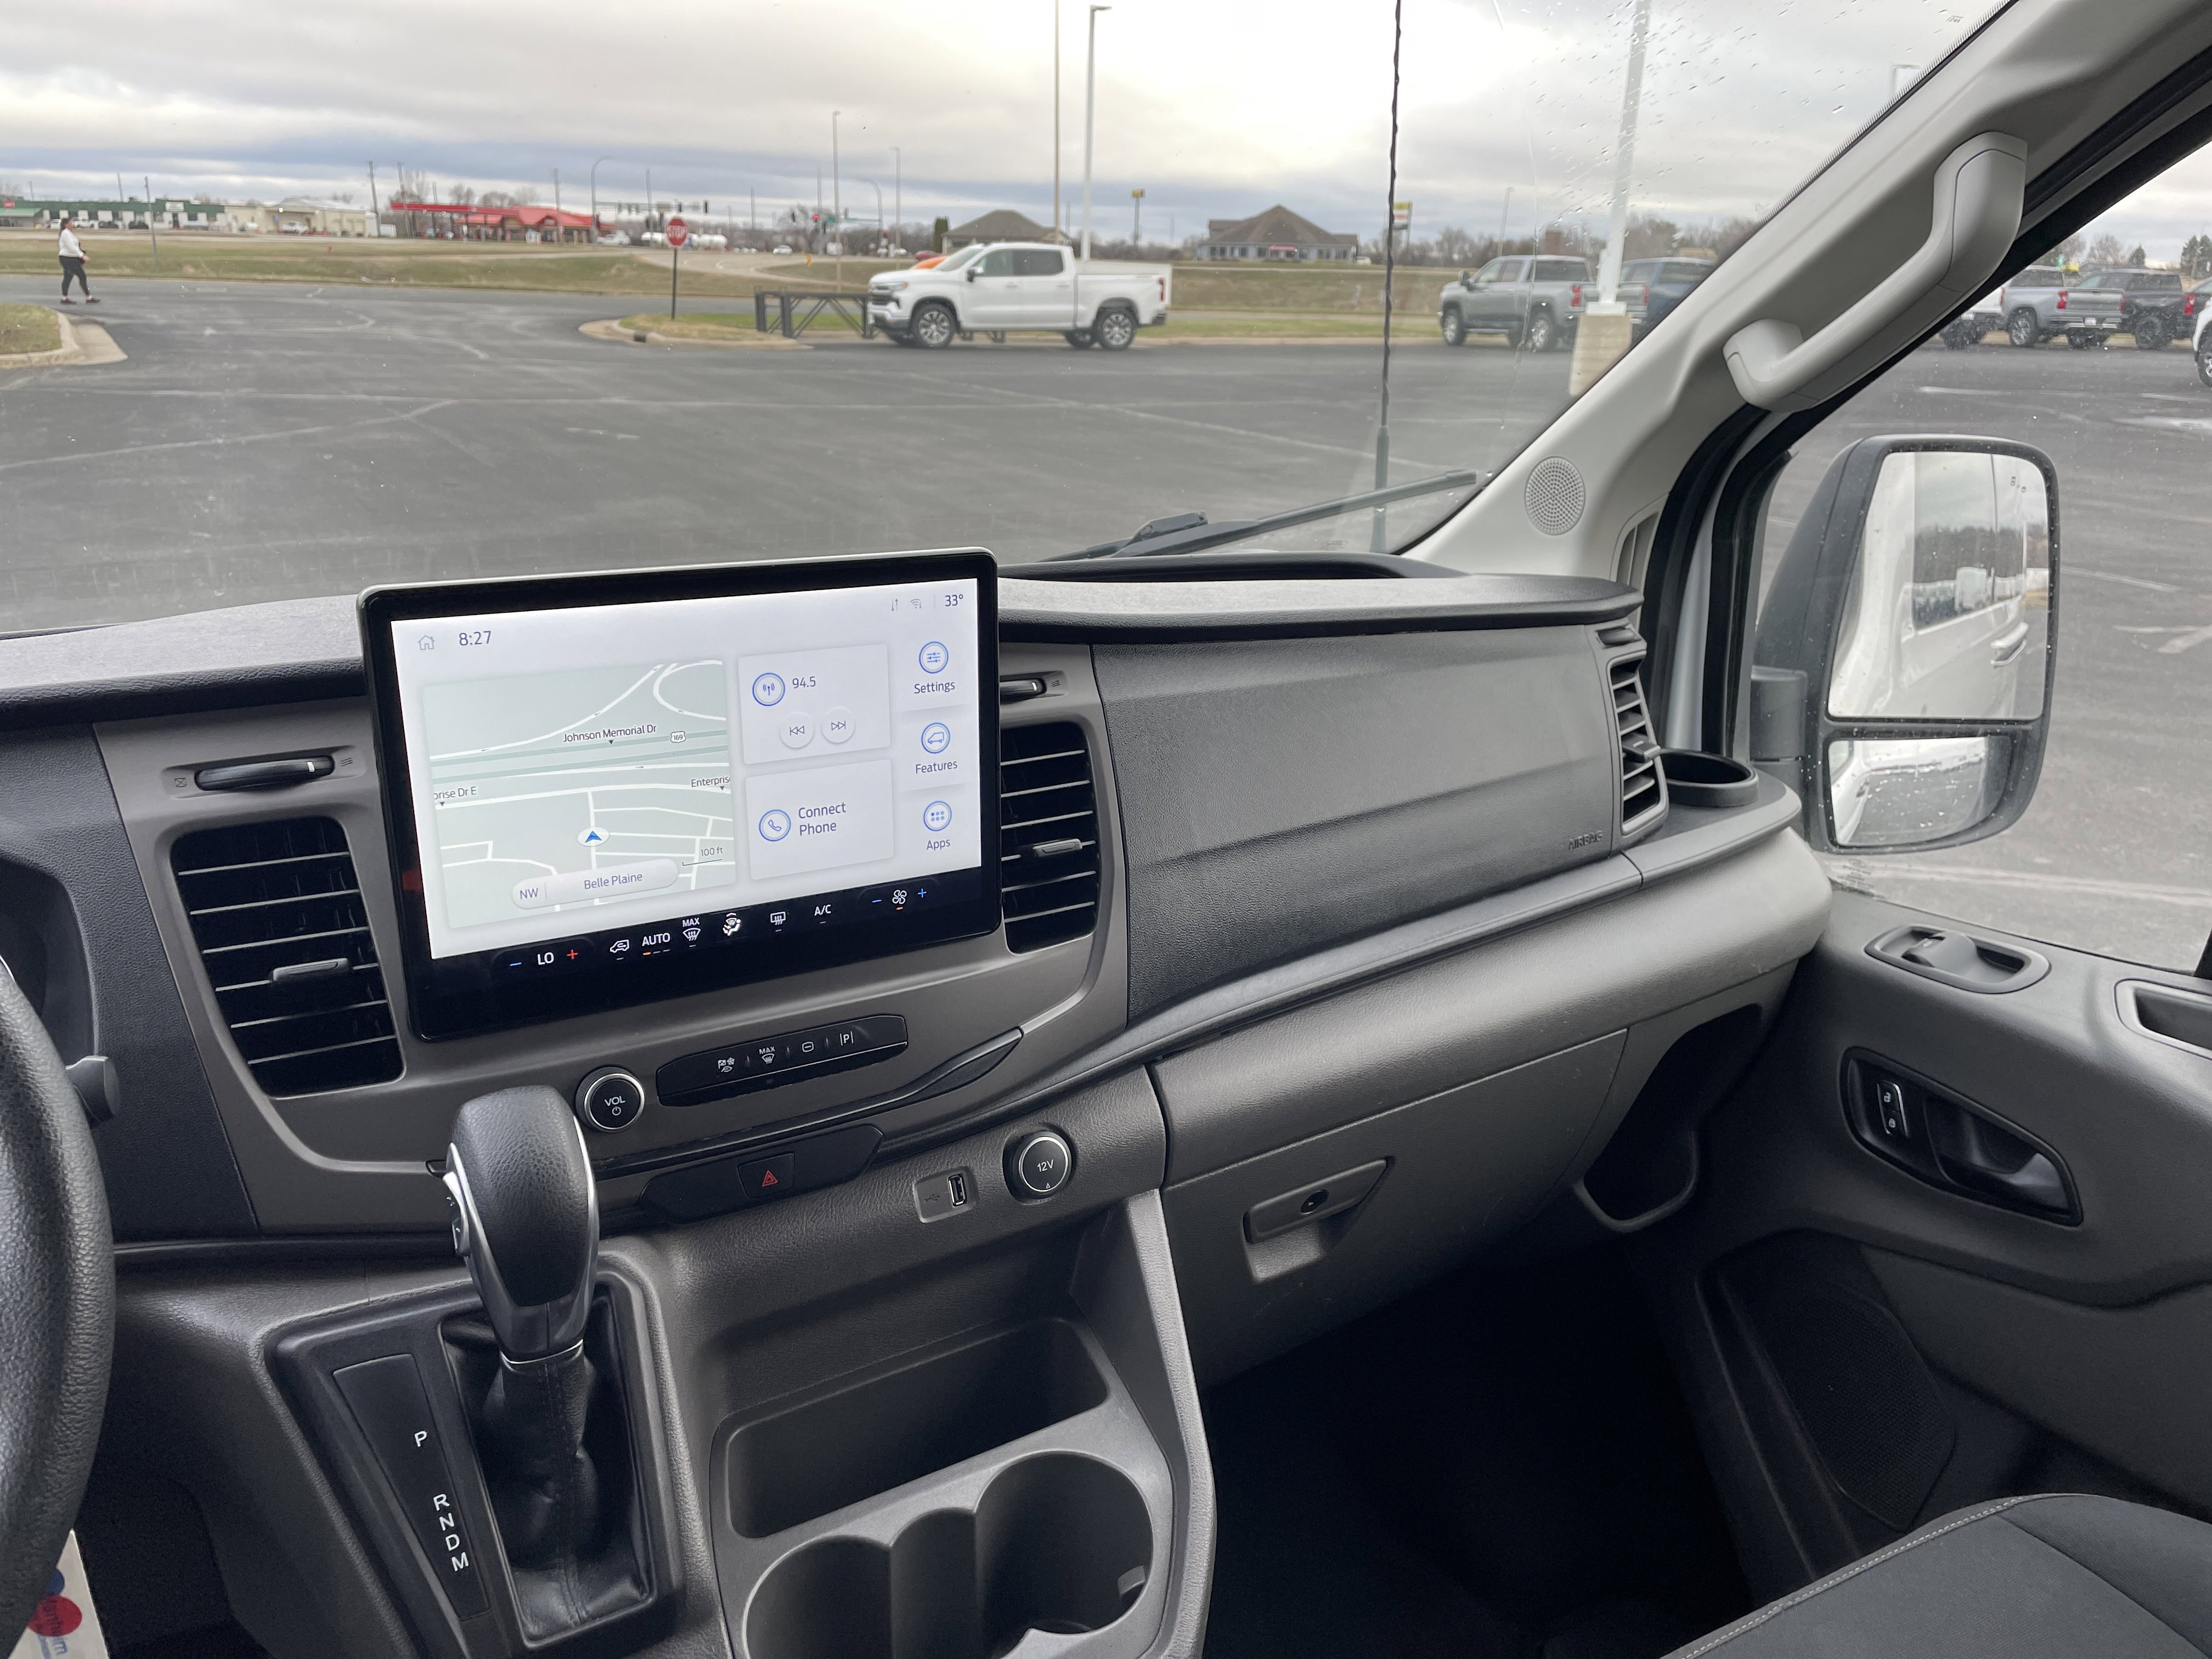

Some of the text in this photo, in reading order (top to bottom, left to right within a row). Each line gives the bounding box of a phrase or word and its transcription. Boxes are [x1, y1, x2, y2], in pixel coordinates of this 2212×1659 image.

[667, 225, 687, 239] STOP
[459, 630, 492, 646] 8:27
[792, 676, 816, 689] 94.5
[914, 681, 955, 694] Settings
[563, 724, 657, 742] Johnson Memorial Dr
[915, 760, 957, 774] Features
[458, 788, 469, 797] Dr
[471, 786, 477, 795] E
[799, 802, 847, 819] Connect
[799, 821, 837, 836] Phone
[927, 838, 951, 851] Apps
[1568, 830, 1603, 850] AIRBAG
[701, 846, 723, 856] 100 ft
[584, 872, 642, 889] Belle Plaine
[520, 888, 539, 899] NW
[814, 904, 831, 916] A/C
[682, 917, 699, 927] MAX
[642, 933, 670, 946] AUTO
[537, 952, 554, 966] LO
[759, 1046, 775, 1054] MAX
[605, 1095, 626, 1107] VOL
[1037, 1159, 1054, 1172] 12V
[414, 1431, 427, 1447] P
[433, 1494, 450, 1510] R
[439, 1513, 455, 1531] N
[445, 1534, 460, 1551] D
[451, 1553, 470, 1571] M
